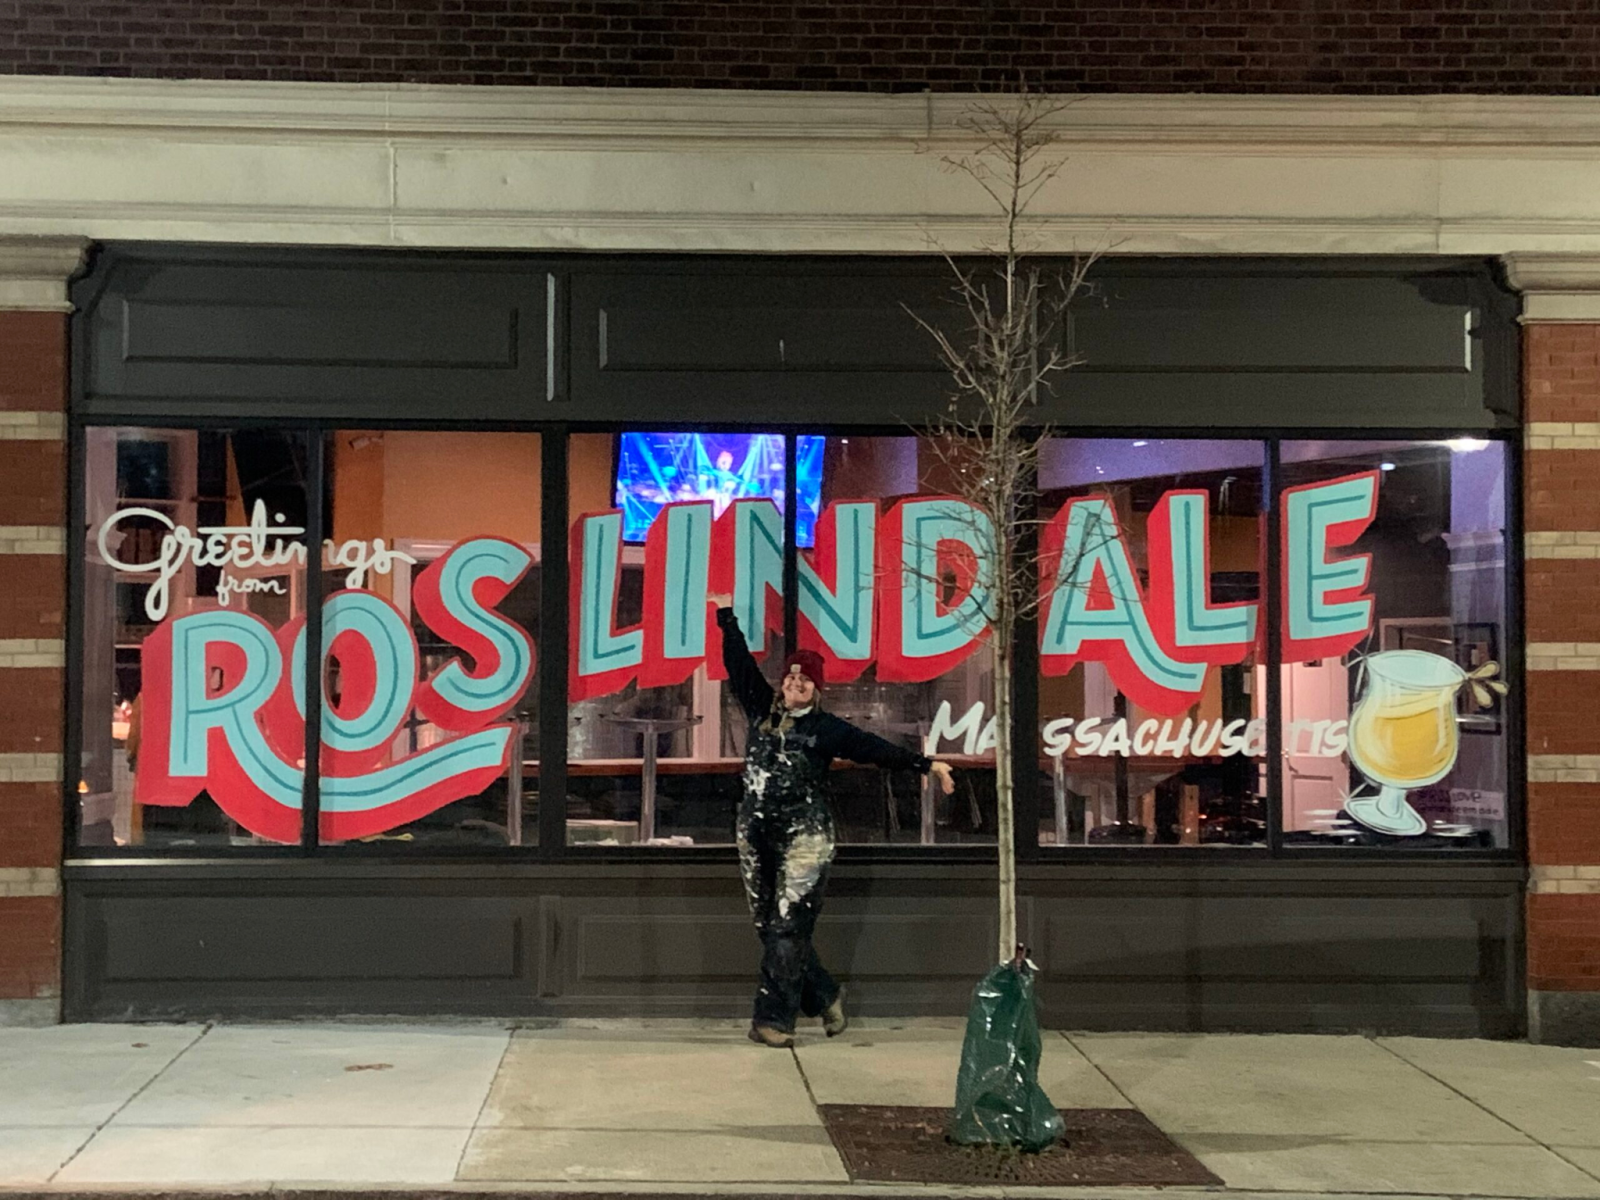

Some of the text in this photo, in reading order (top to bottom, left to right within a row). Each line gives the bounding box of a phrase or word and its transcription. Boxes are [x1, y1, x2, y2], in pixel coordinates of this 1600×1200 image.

[98, 498, 417, 621] Greetings
[216, 569, 287, 607] from
[136, 470, 1380, 842] ROSLINDALE
